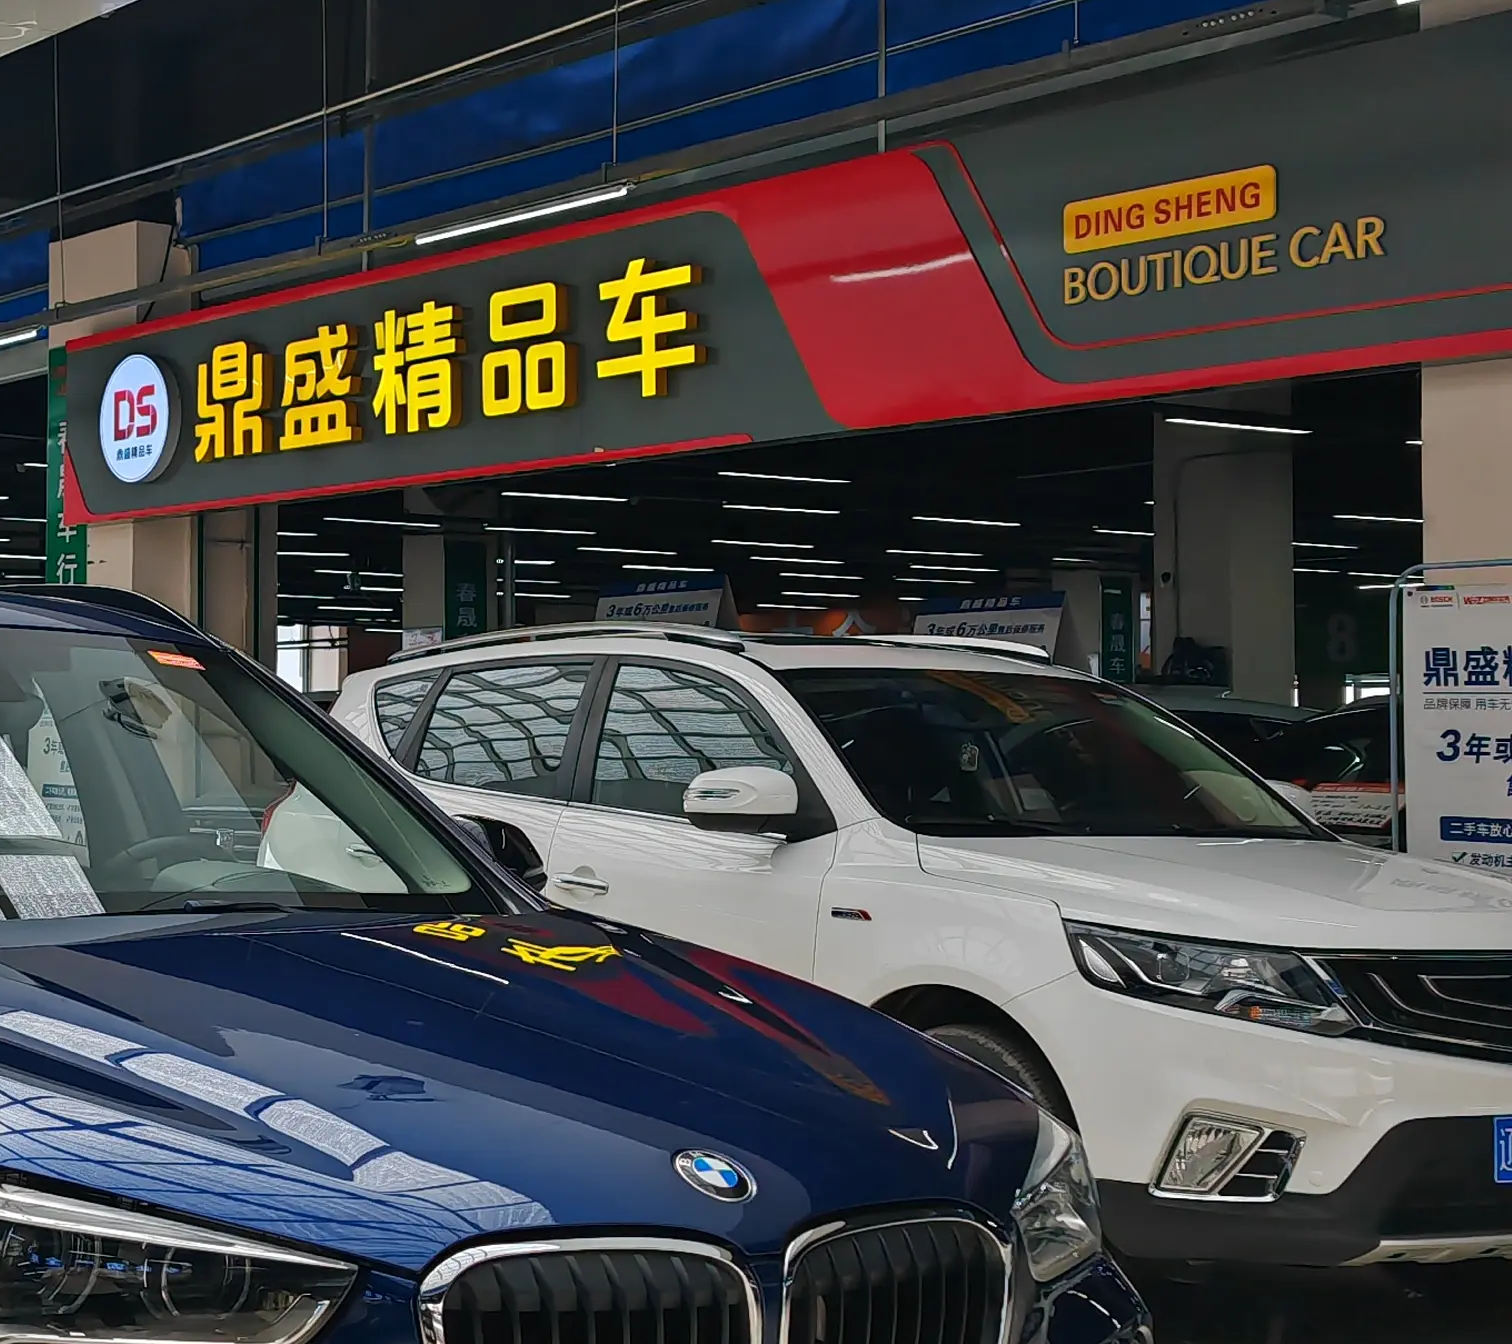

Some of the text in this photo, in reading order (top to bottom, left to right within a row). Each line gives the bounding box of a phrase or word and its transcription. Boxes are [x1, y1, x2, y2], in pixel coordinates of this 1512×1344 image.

[1074, 181, 1262, 240] DING SHENG
[1062, 216, 1387, 305] BOUTIQUE CAR
[194, 257, 698, 463] 鼎盛精品车
[113, 384, 158, 442] DS
[1423, 645, 1512, 687] 鼎盛
